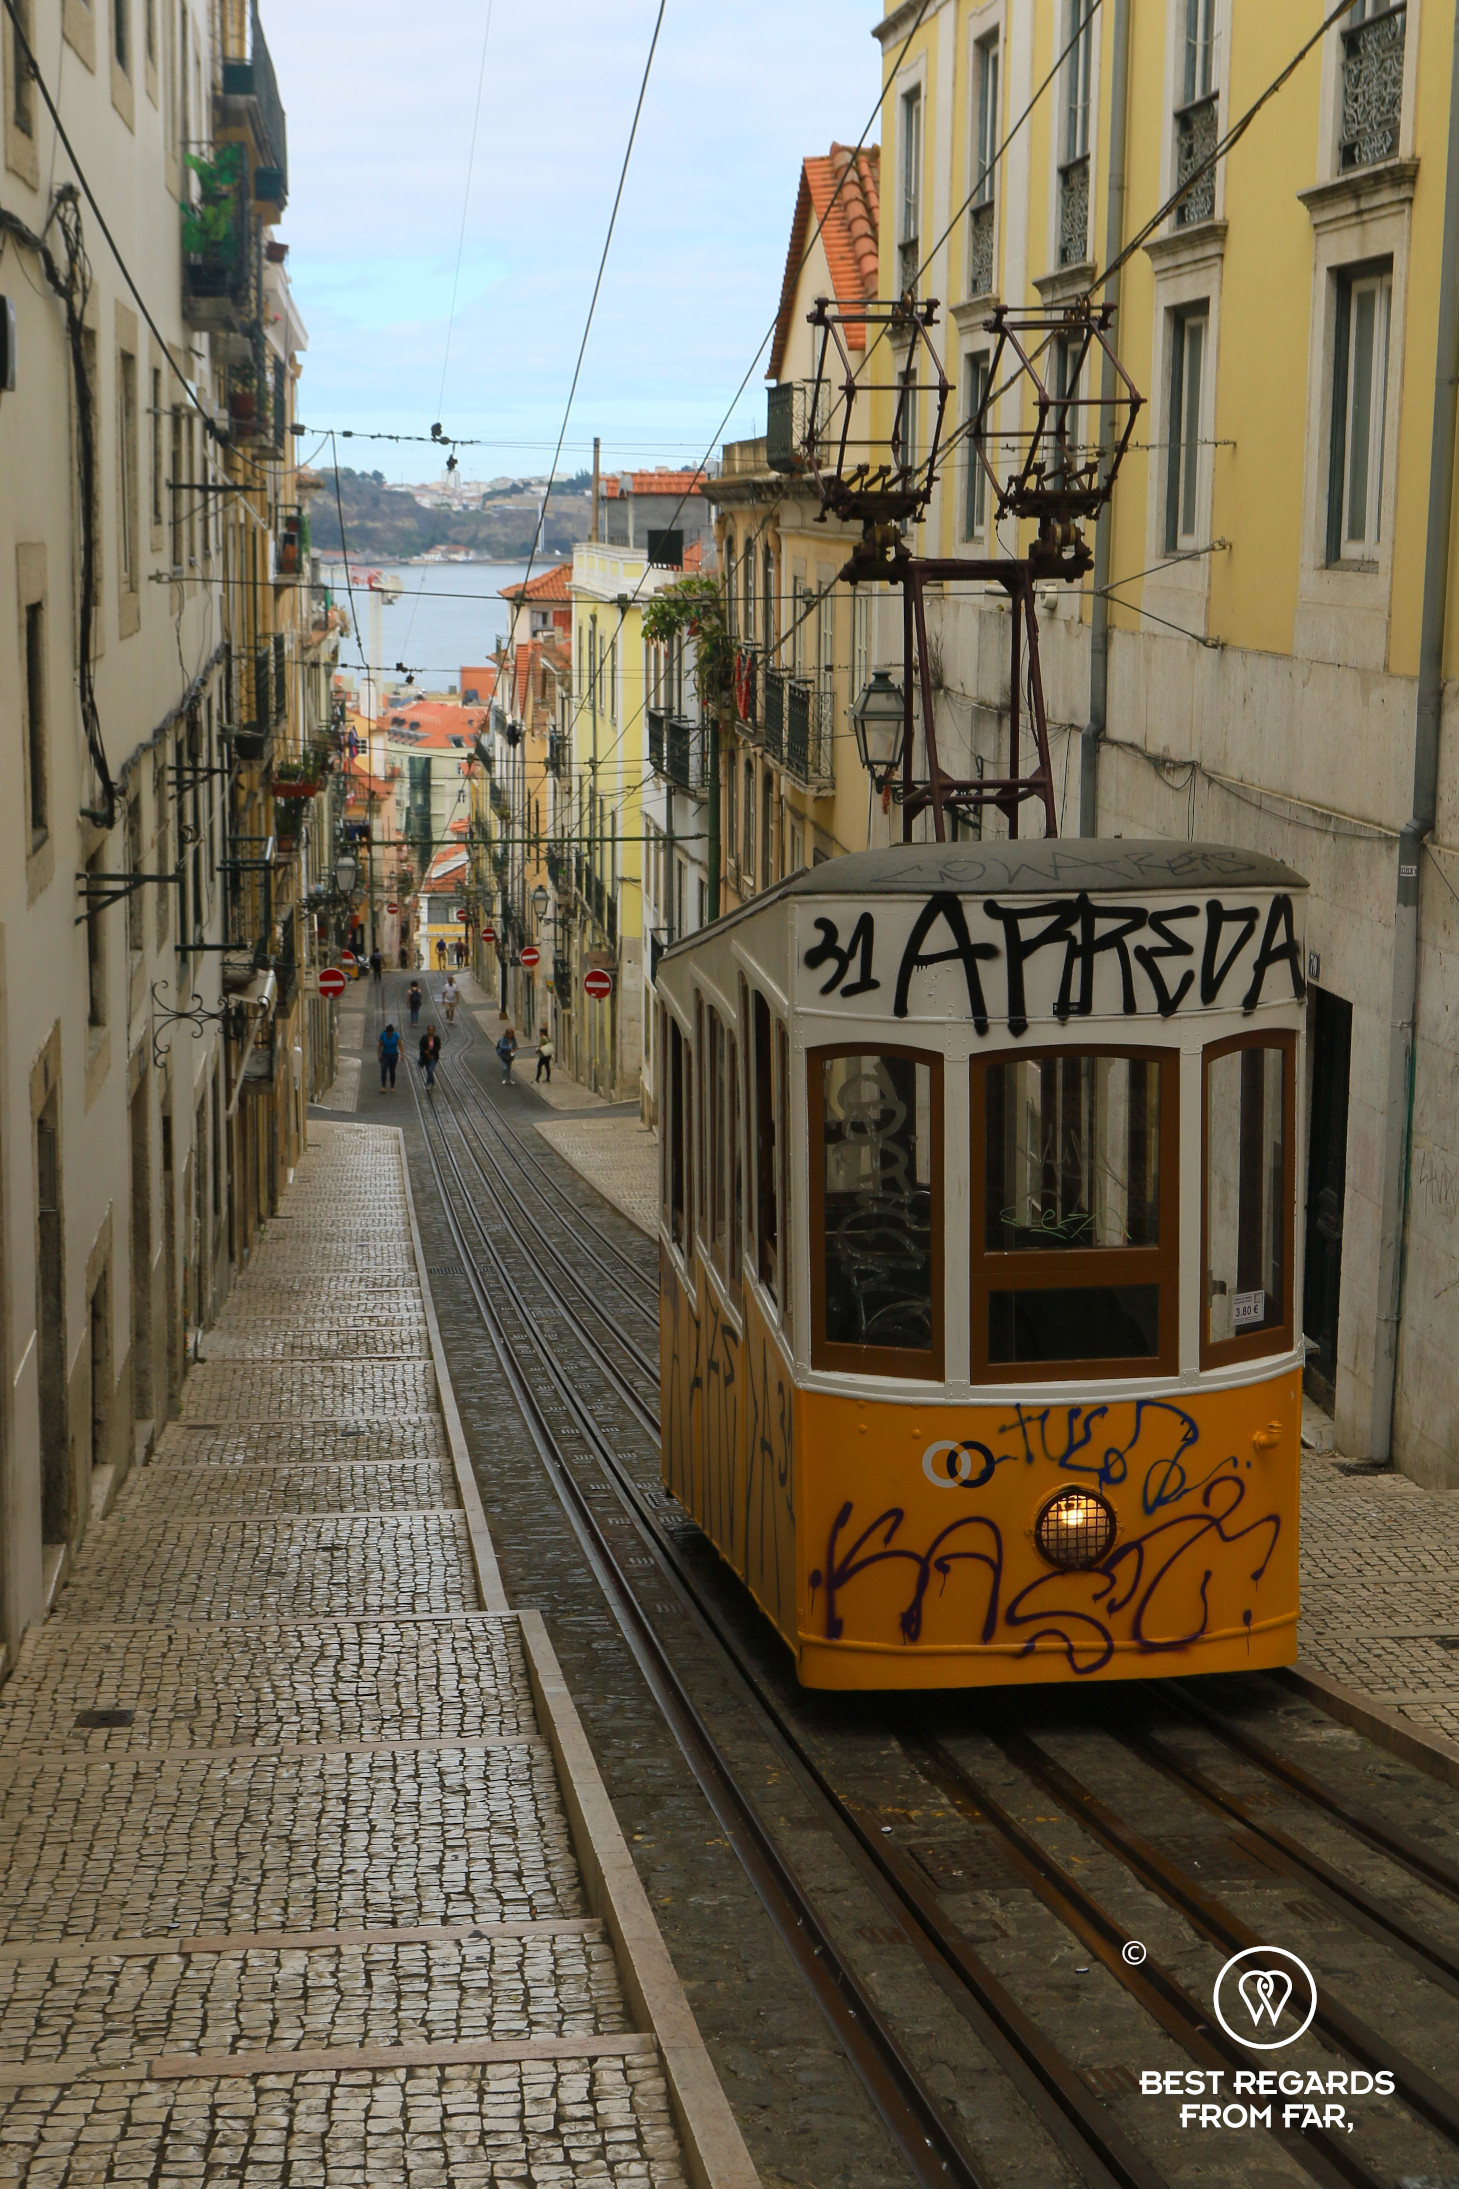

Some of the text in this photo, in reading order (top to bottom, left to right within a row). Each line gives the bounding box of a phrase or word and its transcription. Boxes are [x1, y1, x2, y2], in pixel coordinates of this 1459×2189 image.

[804, 911, 880, 998] 31
[1235, 1304, 1259, 1317] 3.80 €
